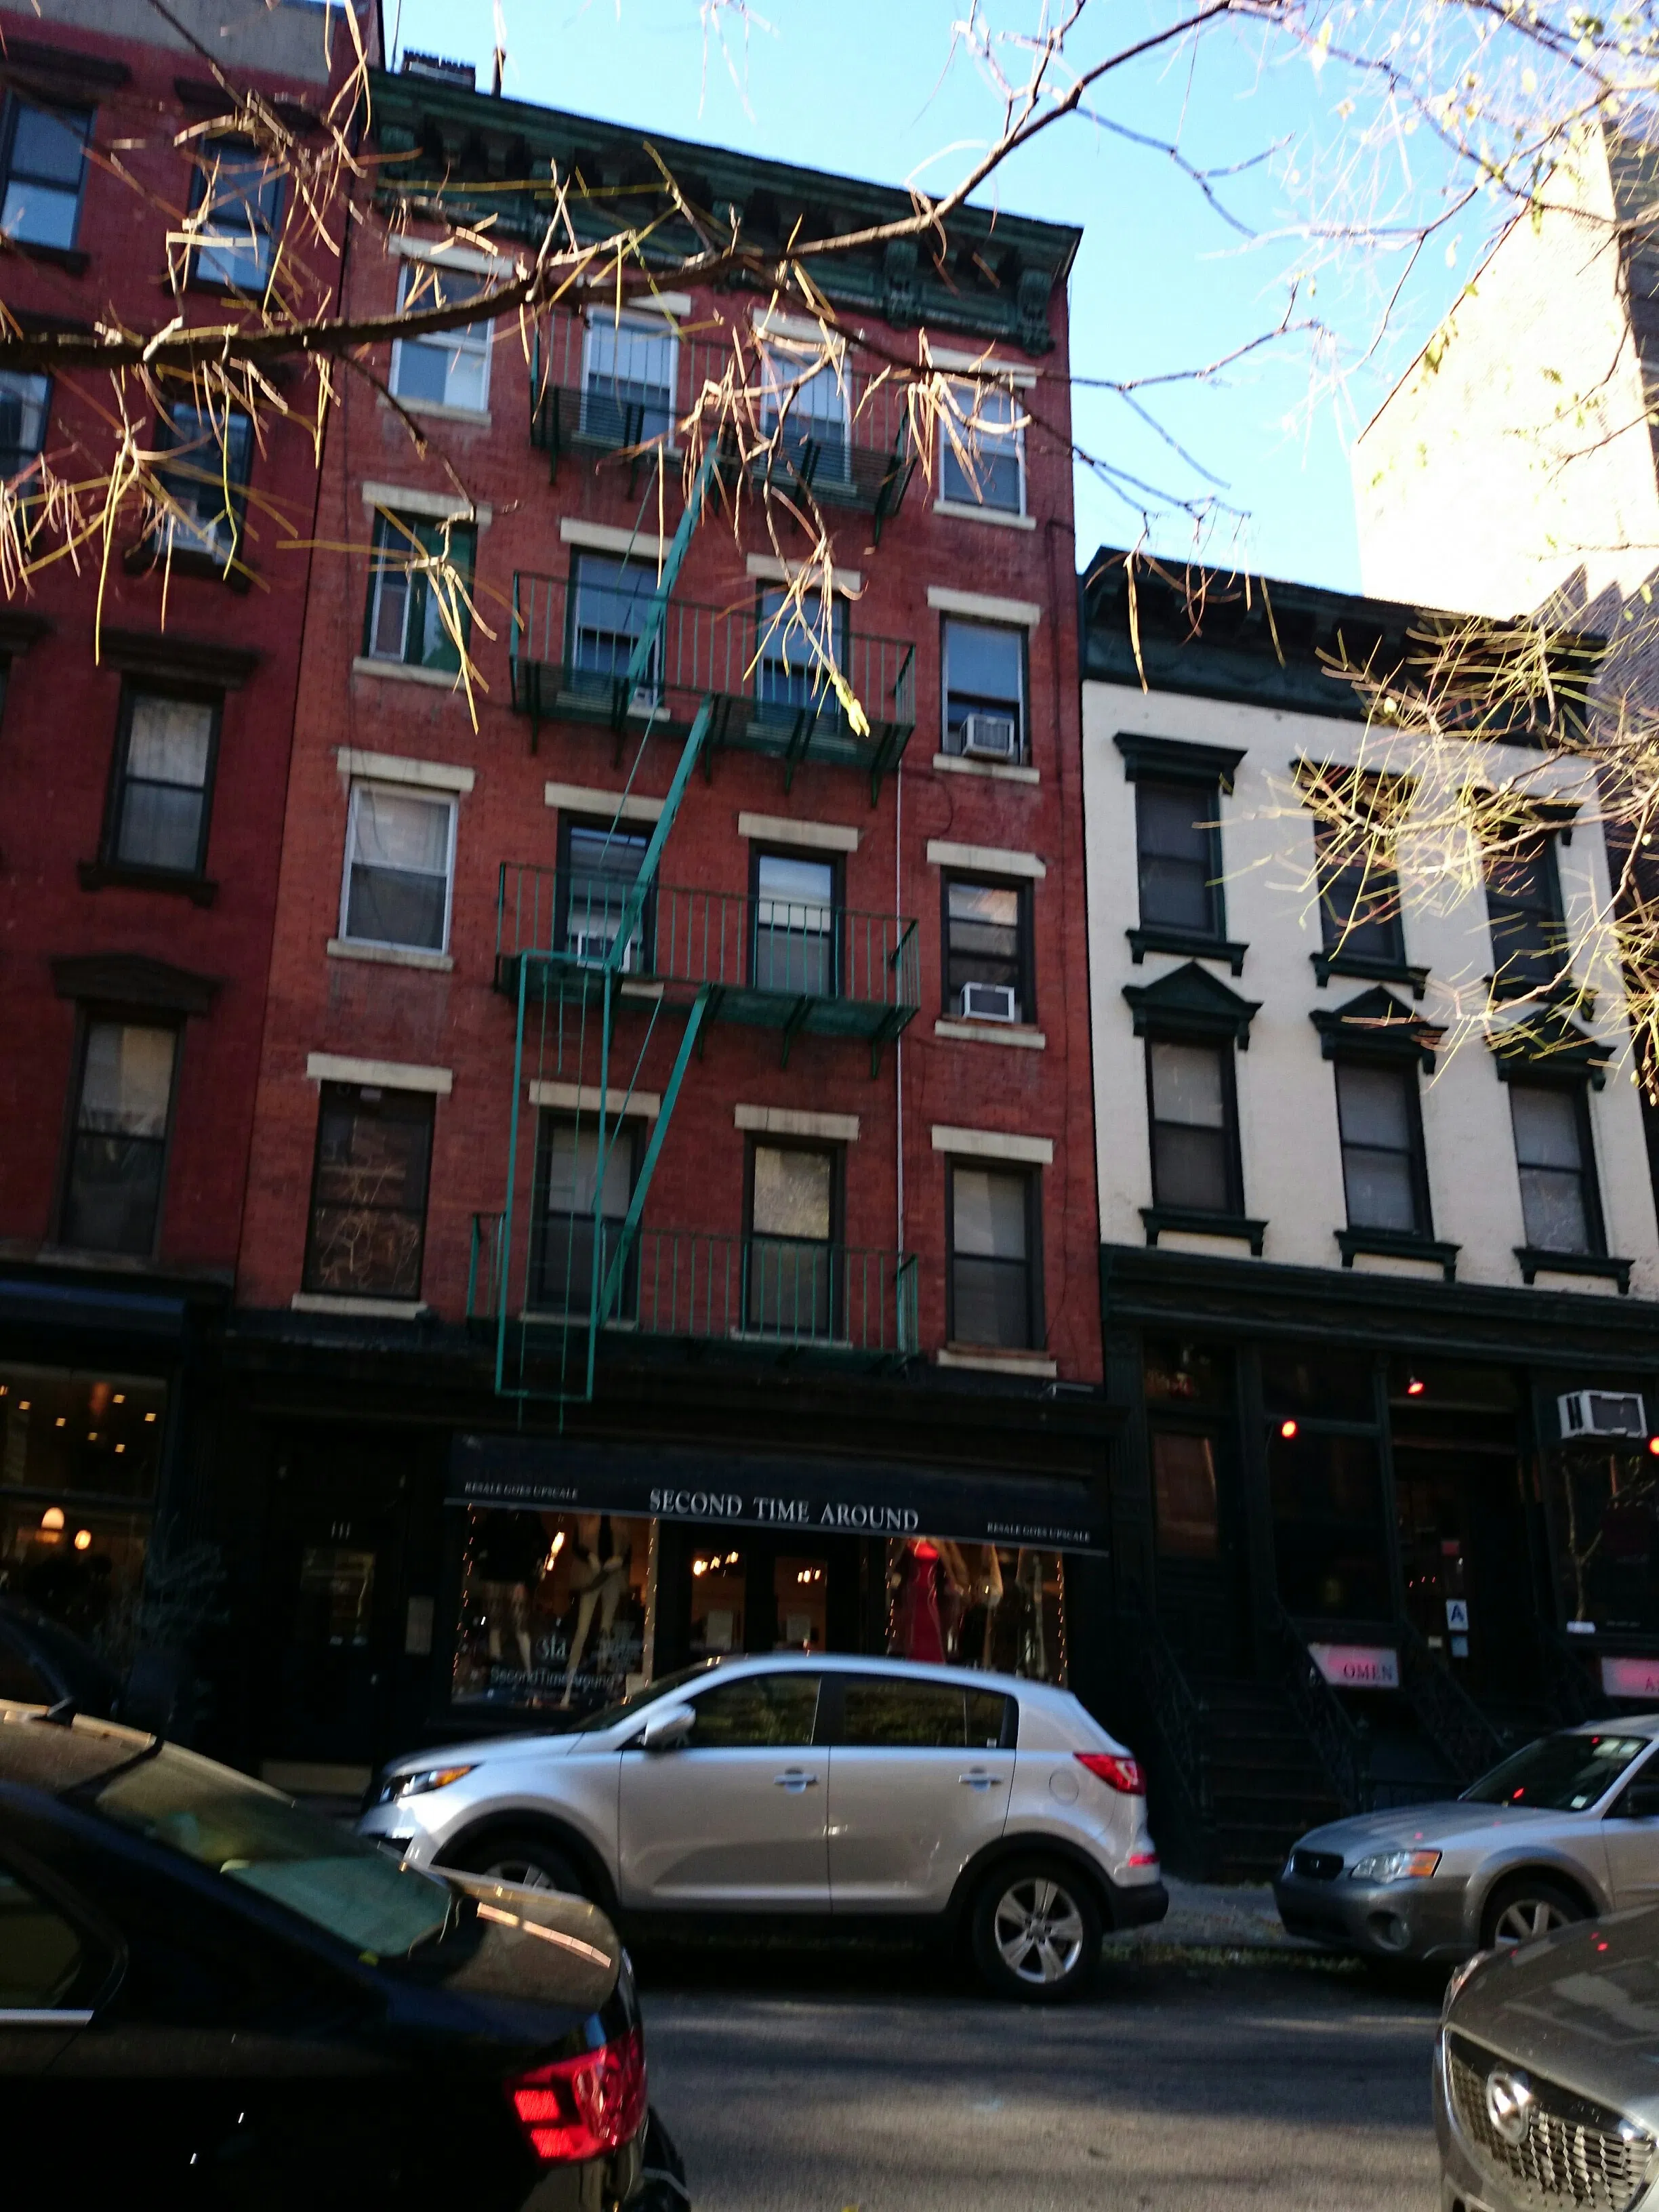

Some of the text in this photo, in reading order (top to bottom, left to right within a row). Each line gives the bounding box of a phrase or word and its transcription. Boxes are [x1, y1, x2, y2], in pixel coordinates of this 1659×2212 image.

[649, 1488, 920, 1532] SECOND TIME AROUND
[1451, 1604, 1465, 1622] A
